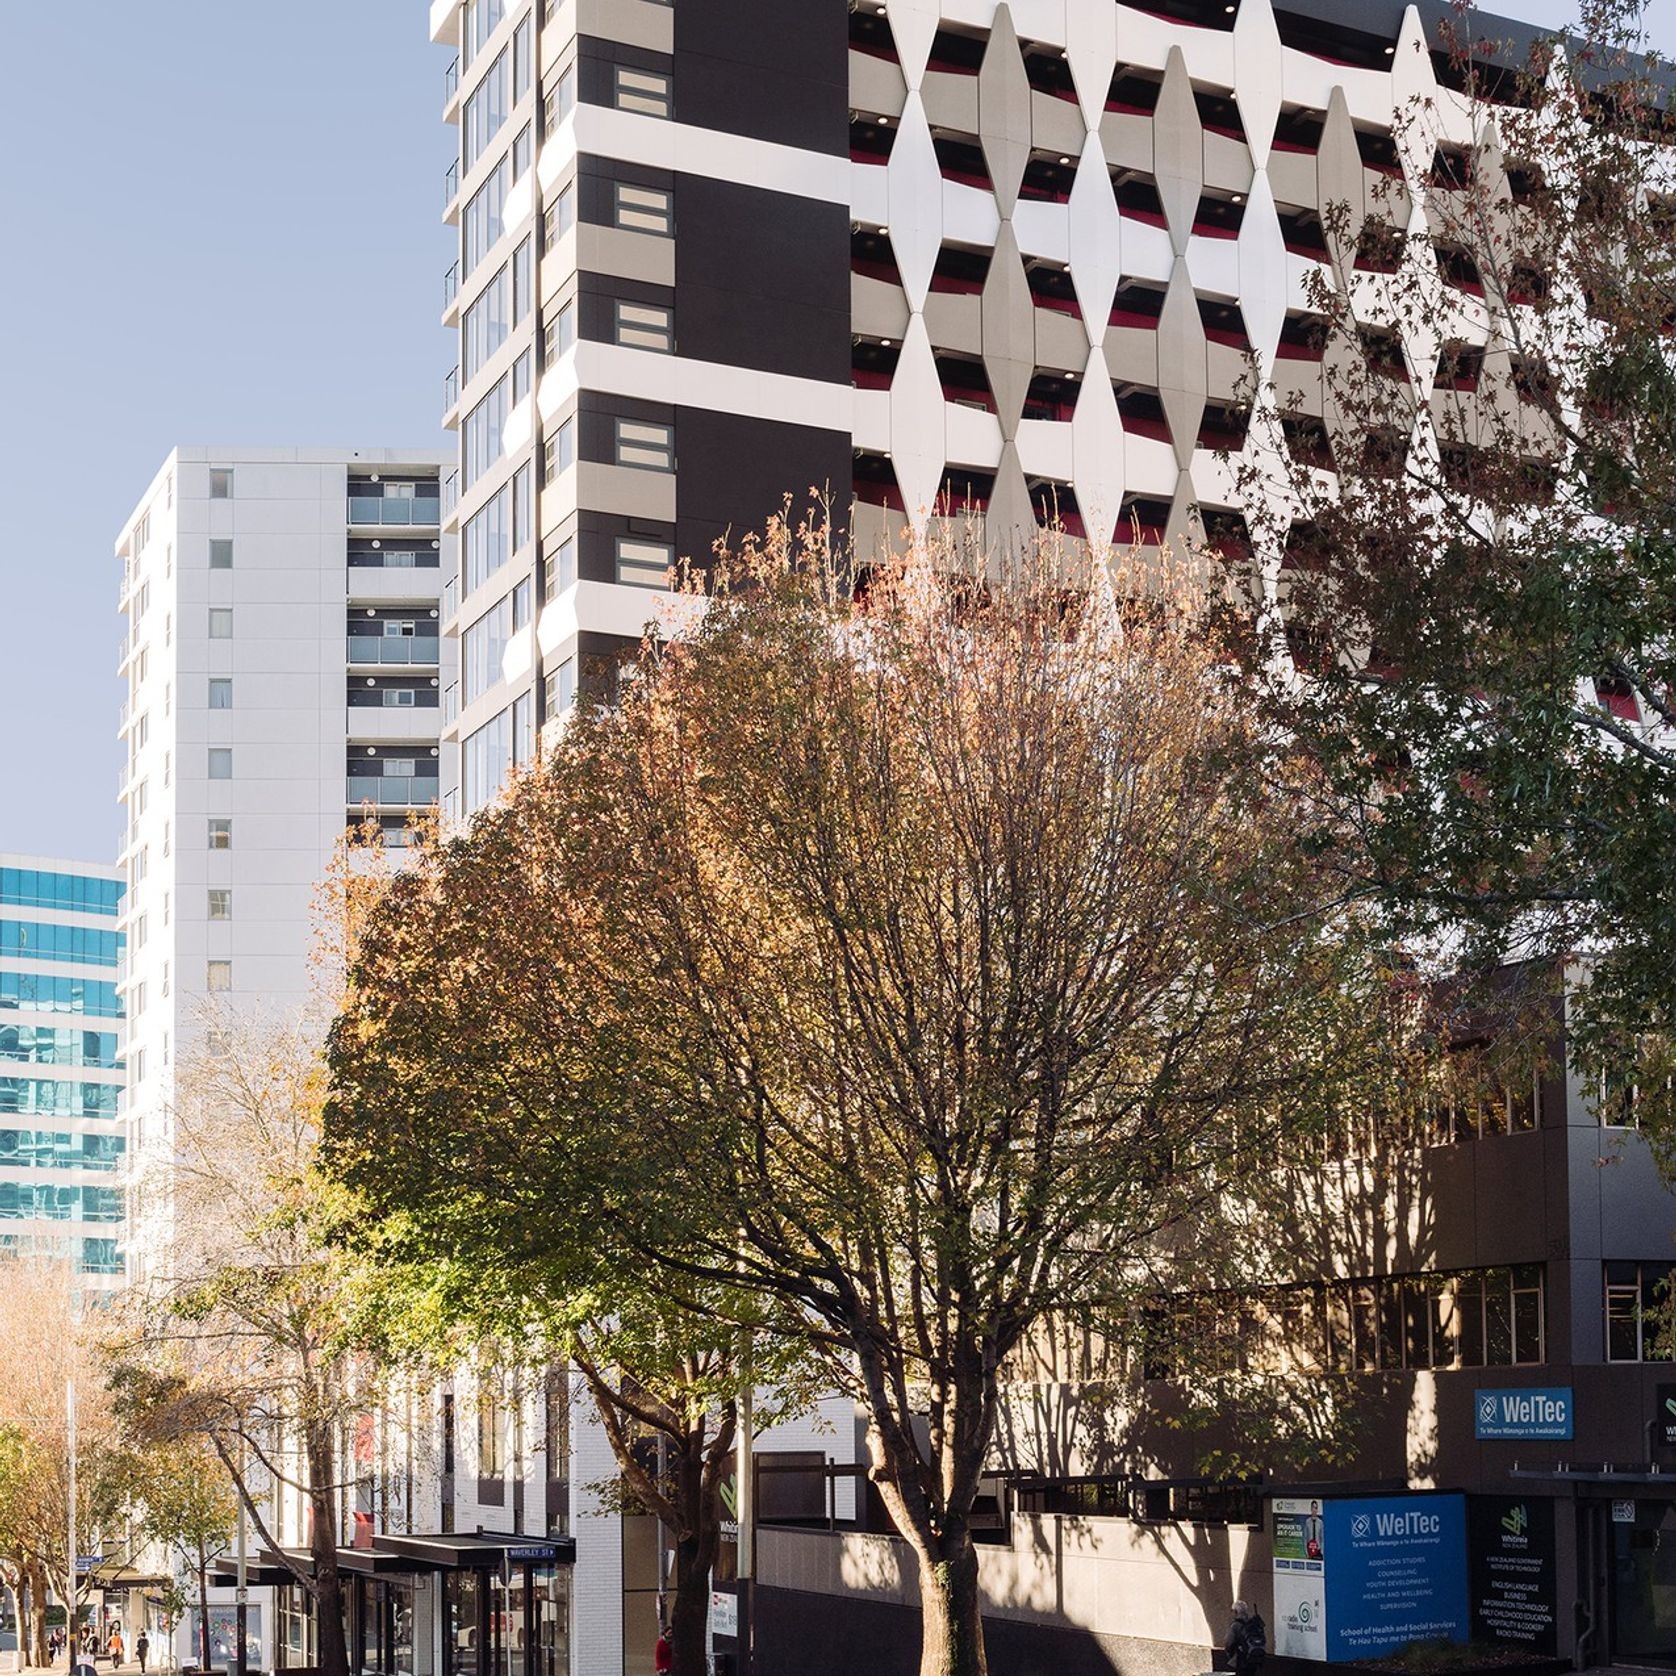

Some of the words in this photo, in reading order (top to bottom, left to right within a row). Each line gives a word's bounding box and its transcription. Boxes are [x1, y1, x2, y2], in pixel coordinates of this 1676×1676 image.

[1502, 1396, 1565, 1422] WelTec
[1376, 1512, 1440, 1536] WelTec
[1368, 1558, 1401, 1567] ADDICTION
[1402, 1557, 1426, 1565] STUDIES
[1377, 1568, 1417, 1577] COUNSELLING
[1388, 1578, 1429, 1587] DEVELOPMENT
[1362, 1592, 1386, 1600] HEALTH
[1402, 1588, 1433, 1597] WELLBEING
[1379, 1602, 1417, 1610] SUPERVISION
[1340, 1628, 1363, 1637] School
[1364, 1626, 1372, 1635] of
[1373, 1625, 1395, 1634] Health
[1396, 1623, 1408, 1632] and
[1409, 1622, 1428, 1631] Social
[1429, 1620, 1456, 1629] Services
